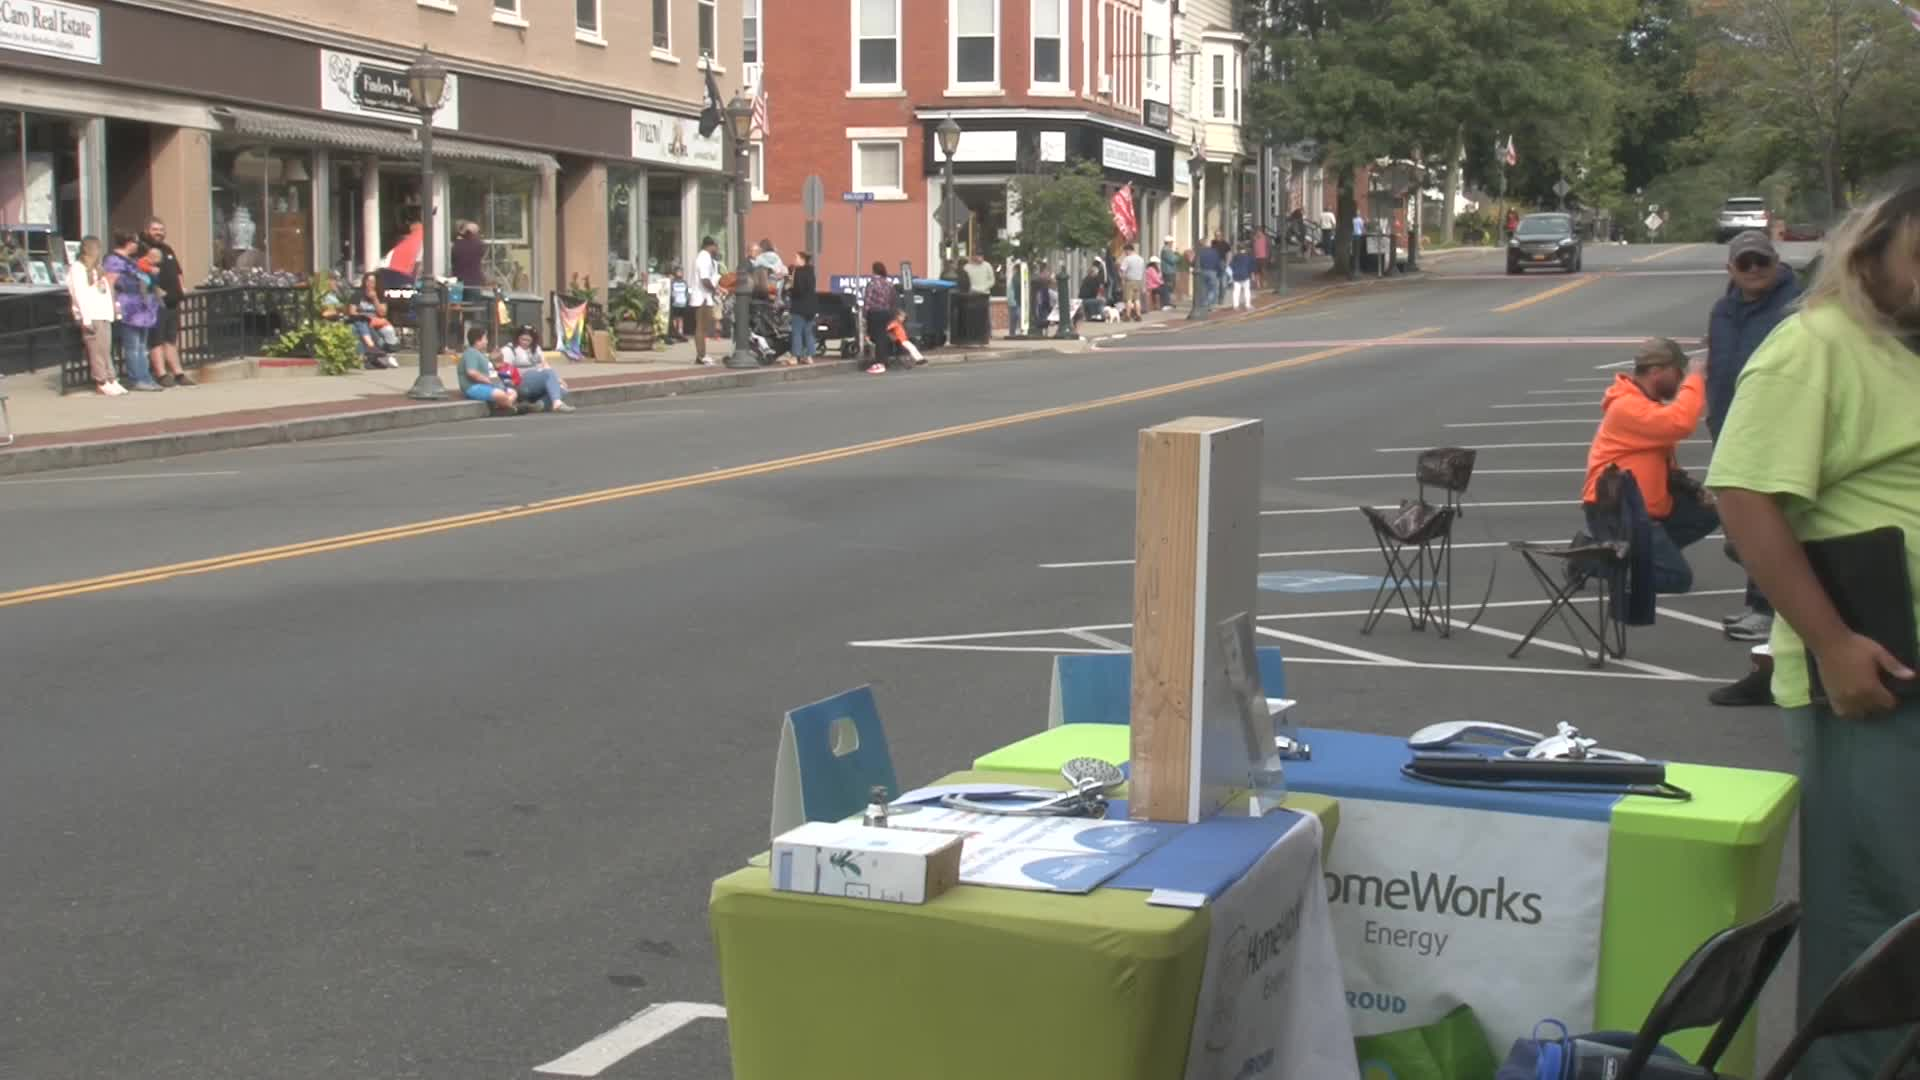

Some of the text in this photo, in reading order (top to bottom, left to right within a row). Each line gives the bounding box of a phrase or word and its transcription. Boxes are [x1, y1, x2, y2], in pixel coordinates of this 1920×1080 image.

[0, 0, 92, 39] Caro Real Estate
[363, 73, 413, 103] Finders Keep
[1325, 870, 1543, 925] omeWorks
[1364, 919, 1449, 957] Energy
[1345, 990, 1408, 1014] ROUD
